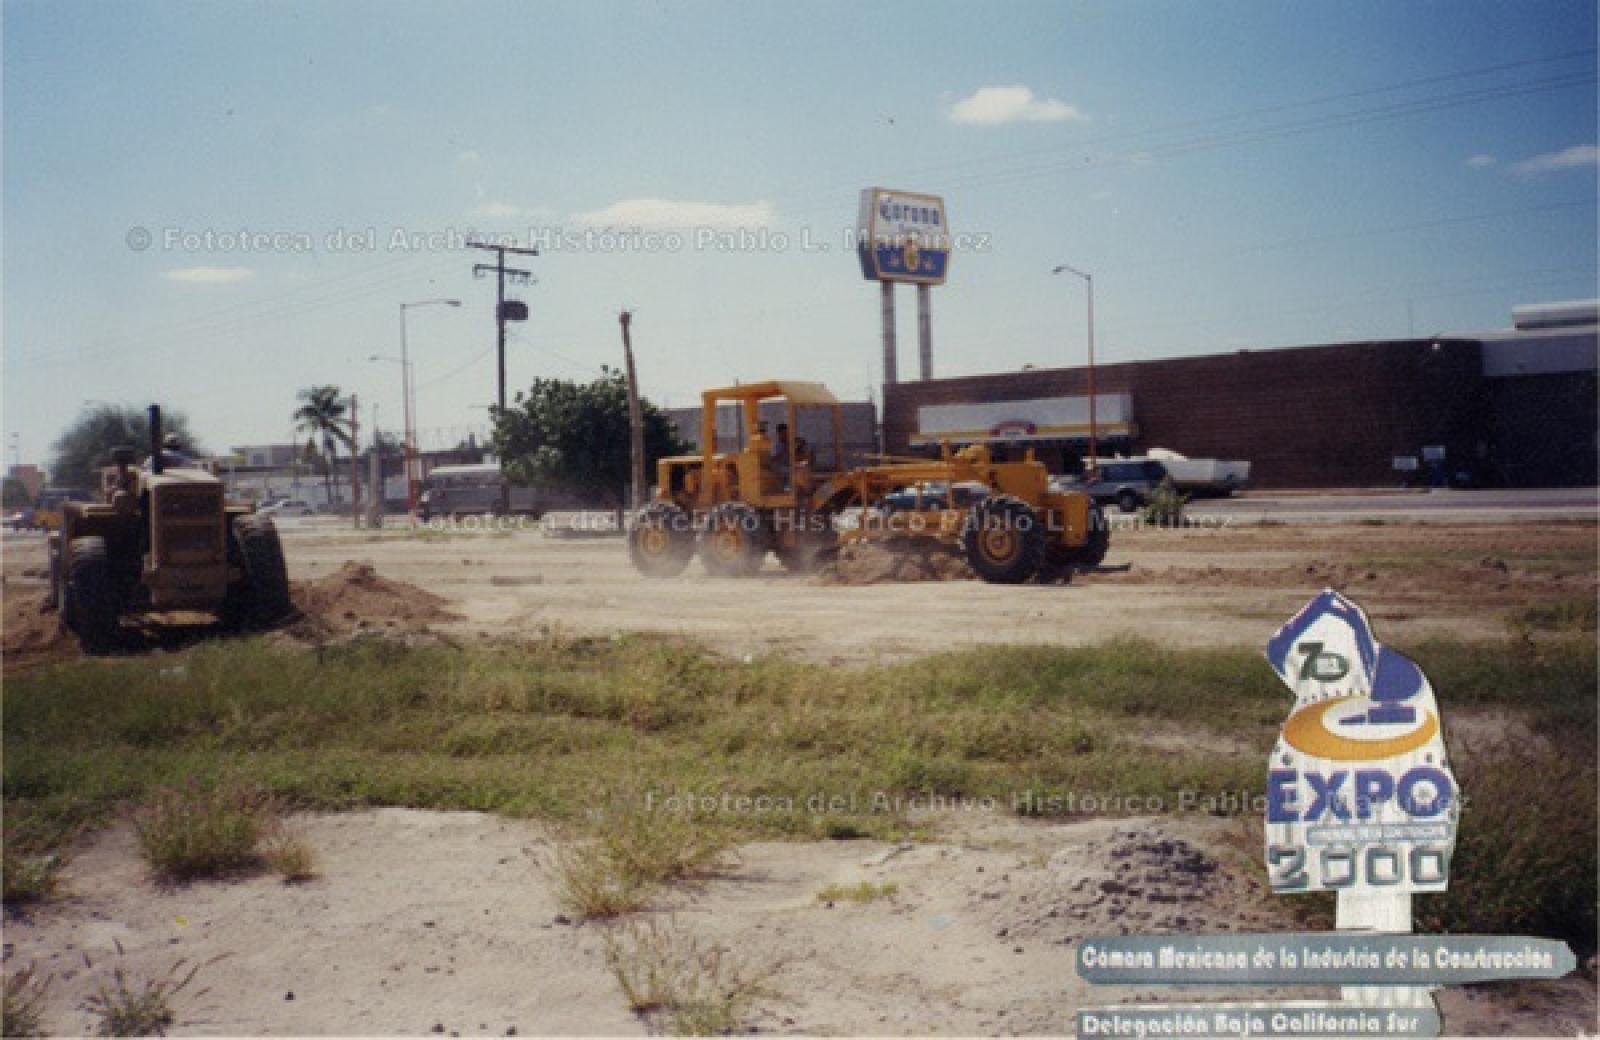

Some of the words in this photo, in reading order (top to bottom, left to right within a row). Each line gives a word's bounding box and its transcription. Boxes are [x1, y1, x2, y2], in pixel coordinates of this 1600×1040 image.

[879, 197, 939, 225] Corona
[1298, 642, 1349, 682] 70
[1268, 768, 1452, 822] EXPO
[1269, 847, 1449, 888] 2000
[1159, 945, 1247, 968] Mexicana
[1253, 946, 1275, 968] de
[1280, 947, 1297, 968] la
[1303, 946, 1380, 968] Industria
[1384, 946, 1408, 968] de
[1412, 947, 1430, 968] la
[1215, 1012, 1265, 1038] Baja
[1271, 1012, 1380, 1033] California
[1386, 1011, 1417, 1033] Sur
